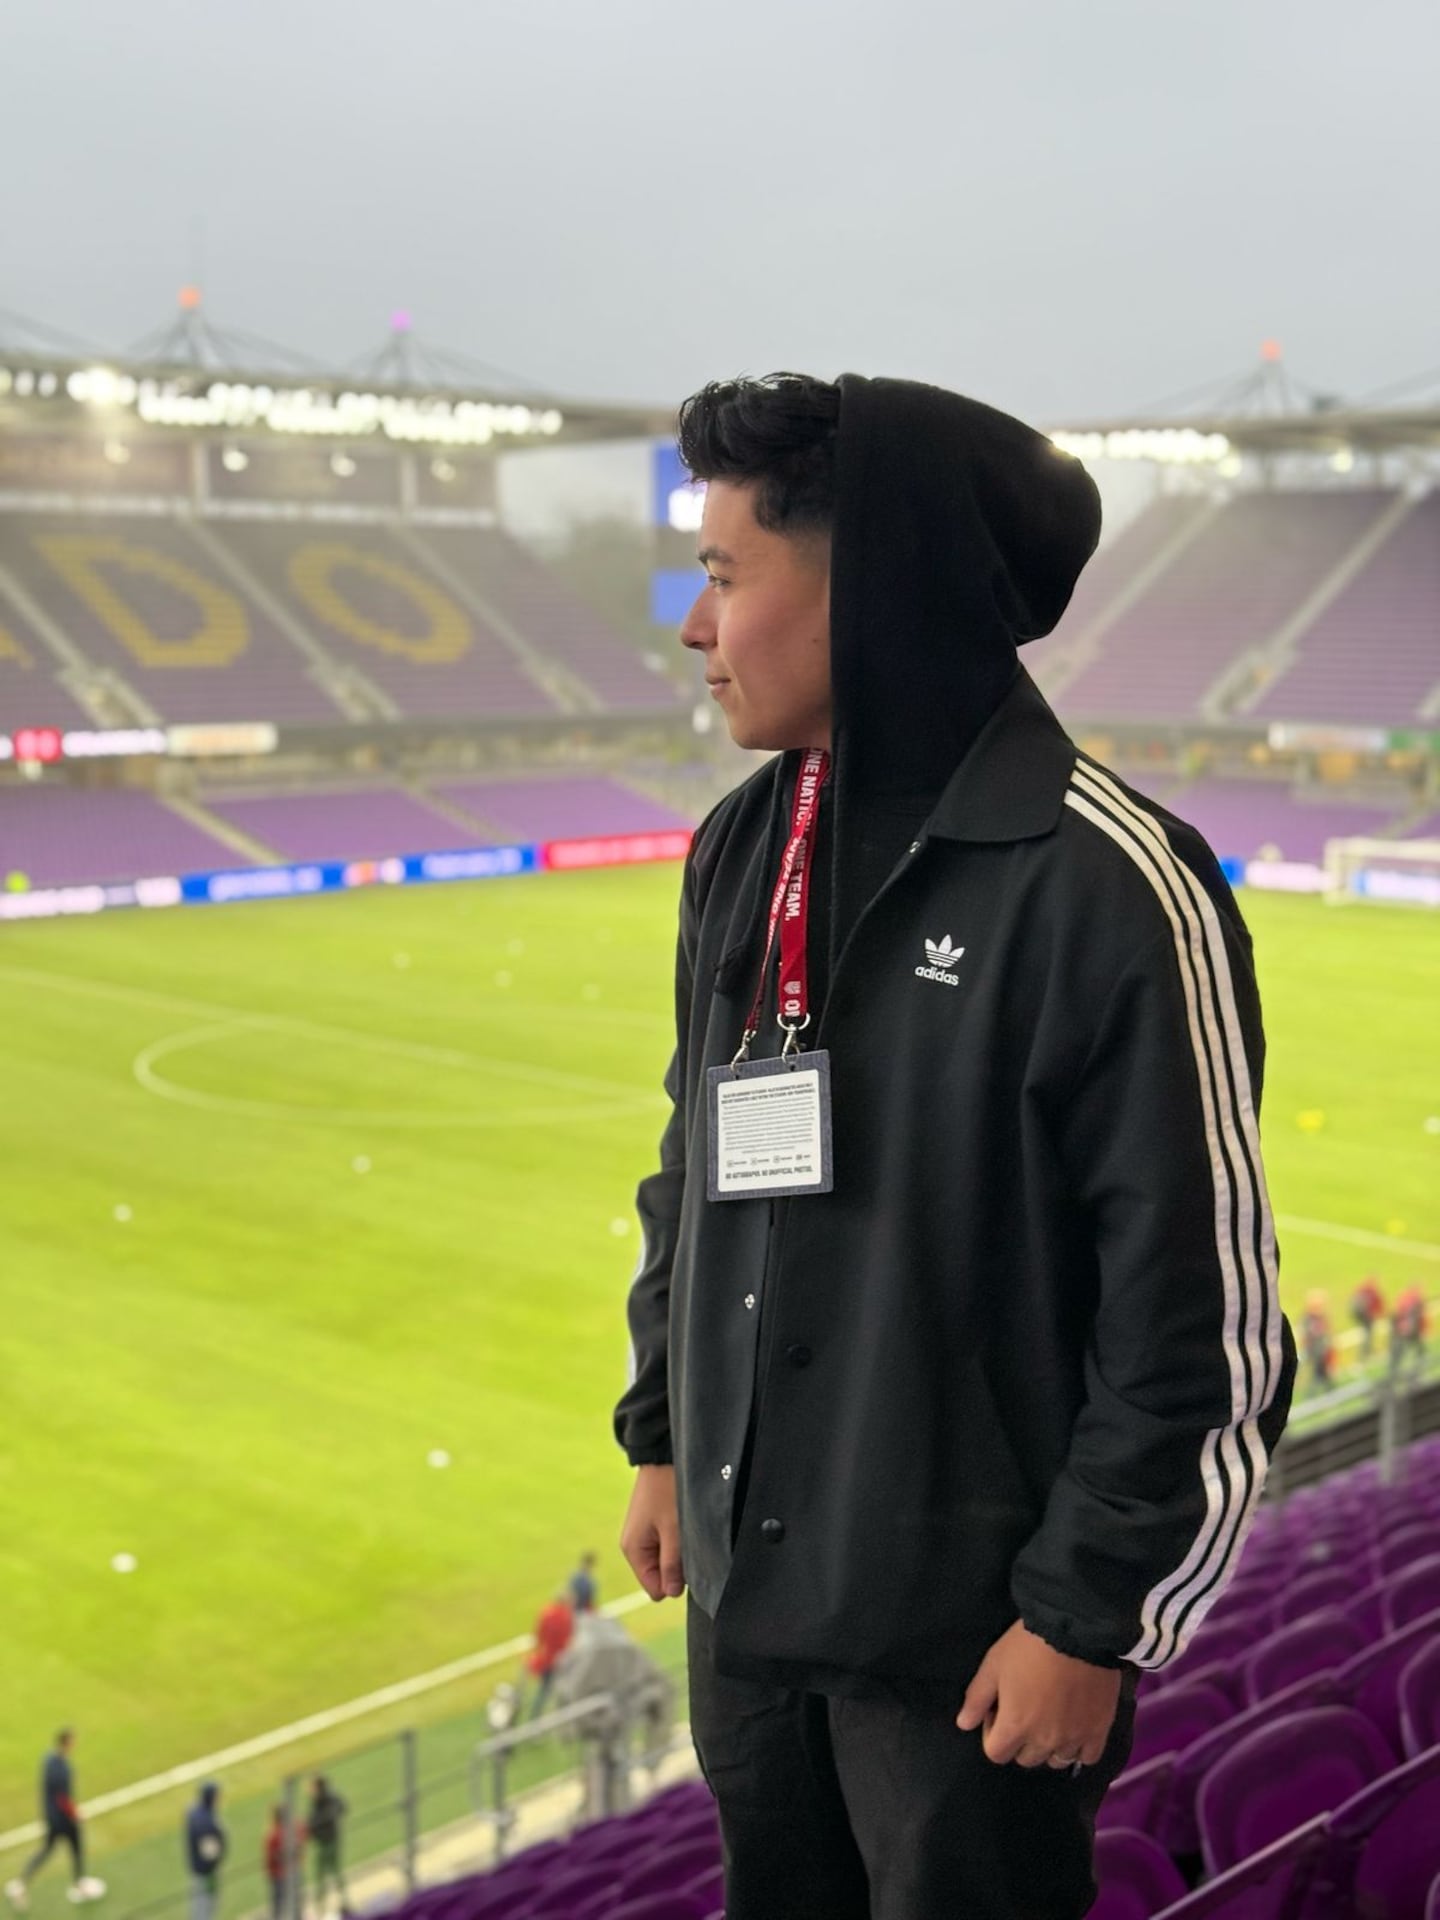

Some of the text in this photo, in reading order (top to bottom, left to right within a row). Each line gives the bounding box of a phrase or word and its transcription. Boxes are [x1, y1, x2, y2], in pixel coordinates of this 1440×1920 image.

[0, 535, 473, 666] DO
[784, 871, 803, 921] TEAM.
[914, 966, 960, 986] adidas
